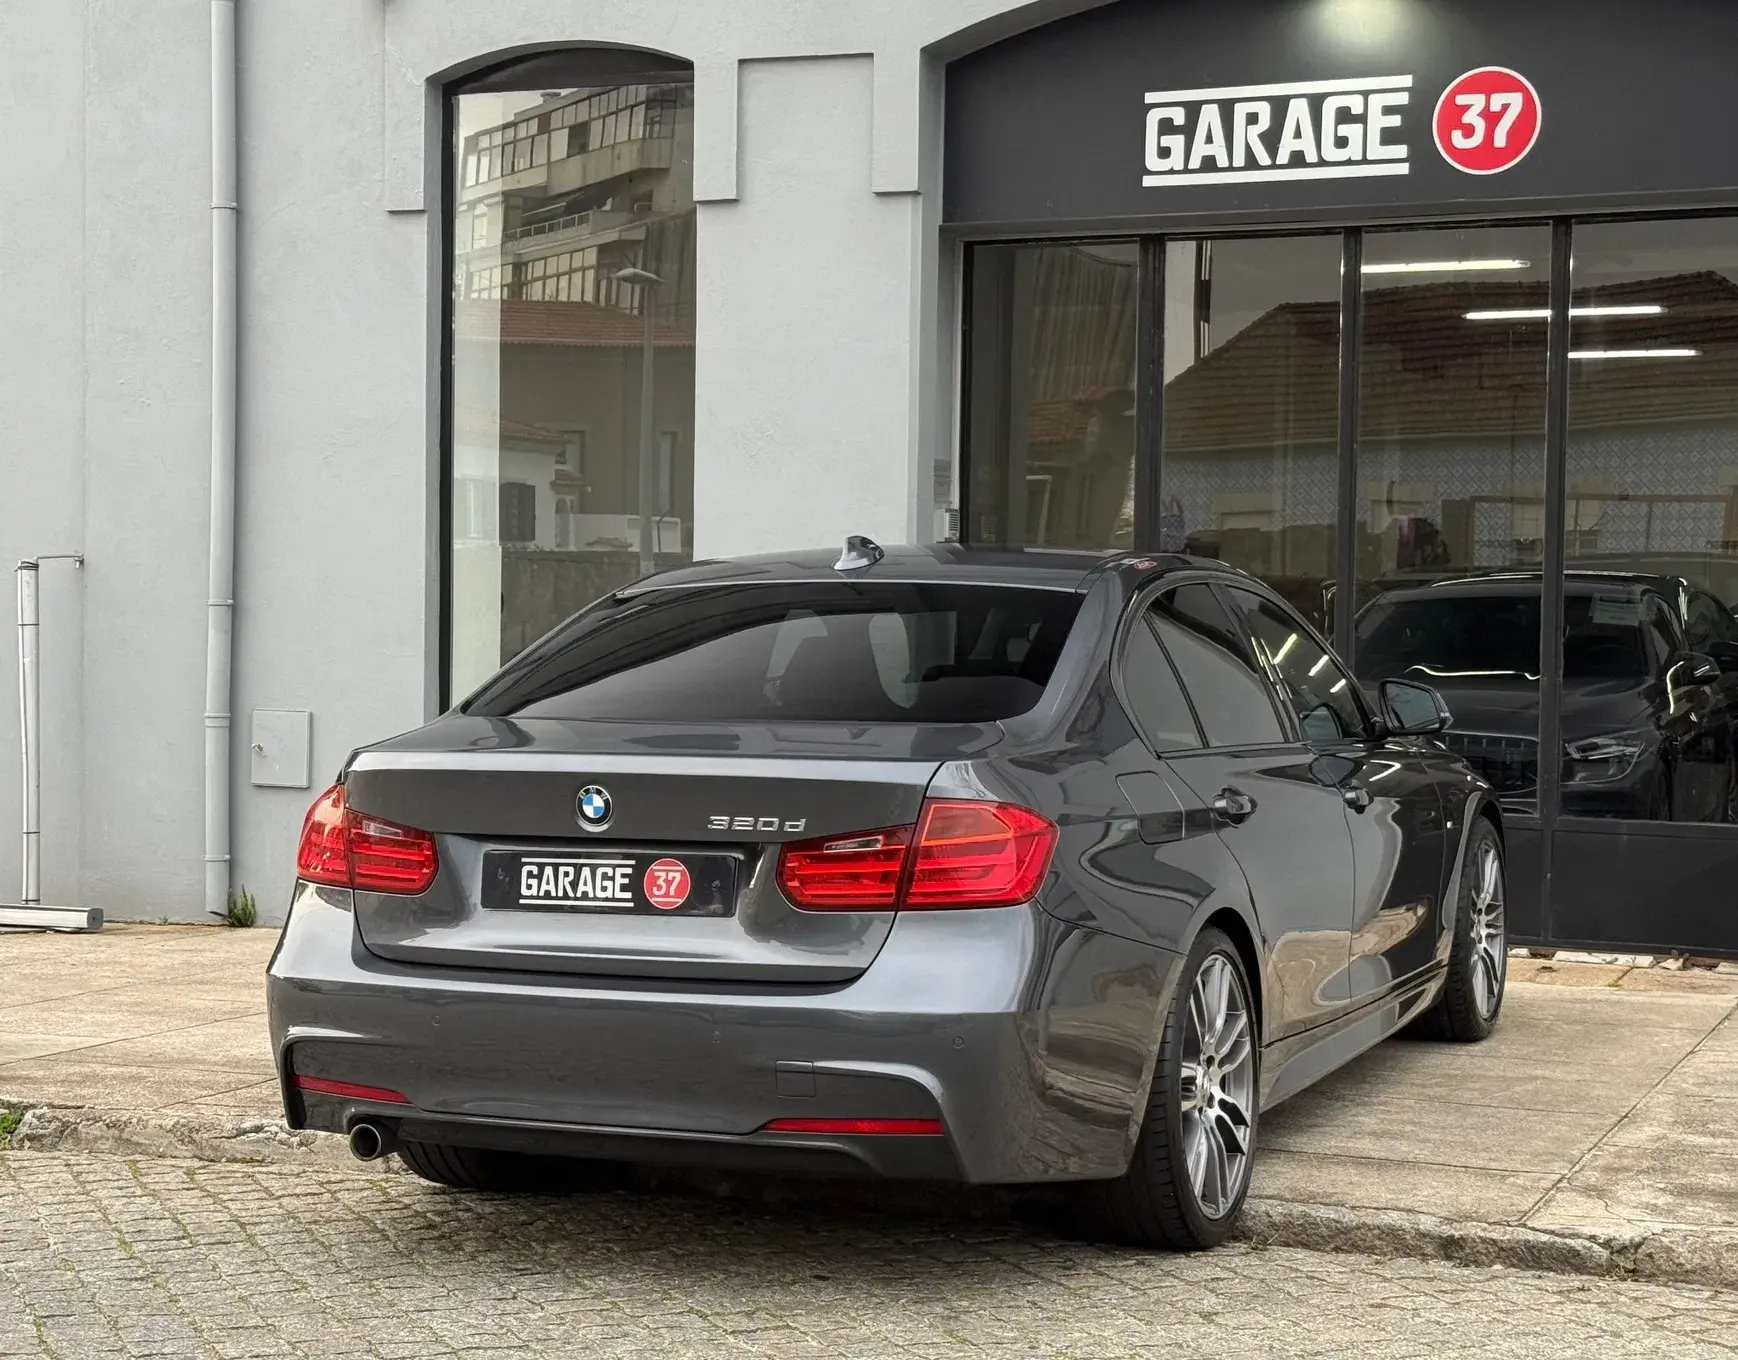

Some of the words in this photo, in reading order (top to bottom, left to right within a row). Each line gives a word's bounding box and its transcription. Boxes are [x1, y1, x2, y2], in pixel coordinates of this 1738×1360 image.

[1145, 92, 1409, 171] GARAGE
[1451, 93, 1523, 149] 37
[521, 865, 633, 898] GARAGE
[652, 871, 683, 897] 37
